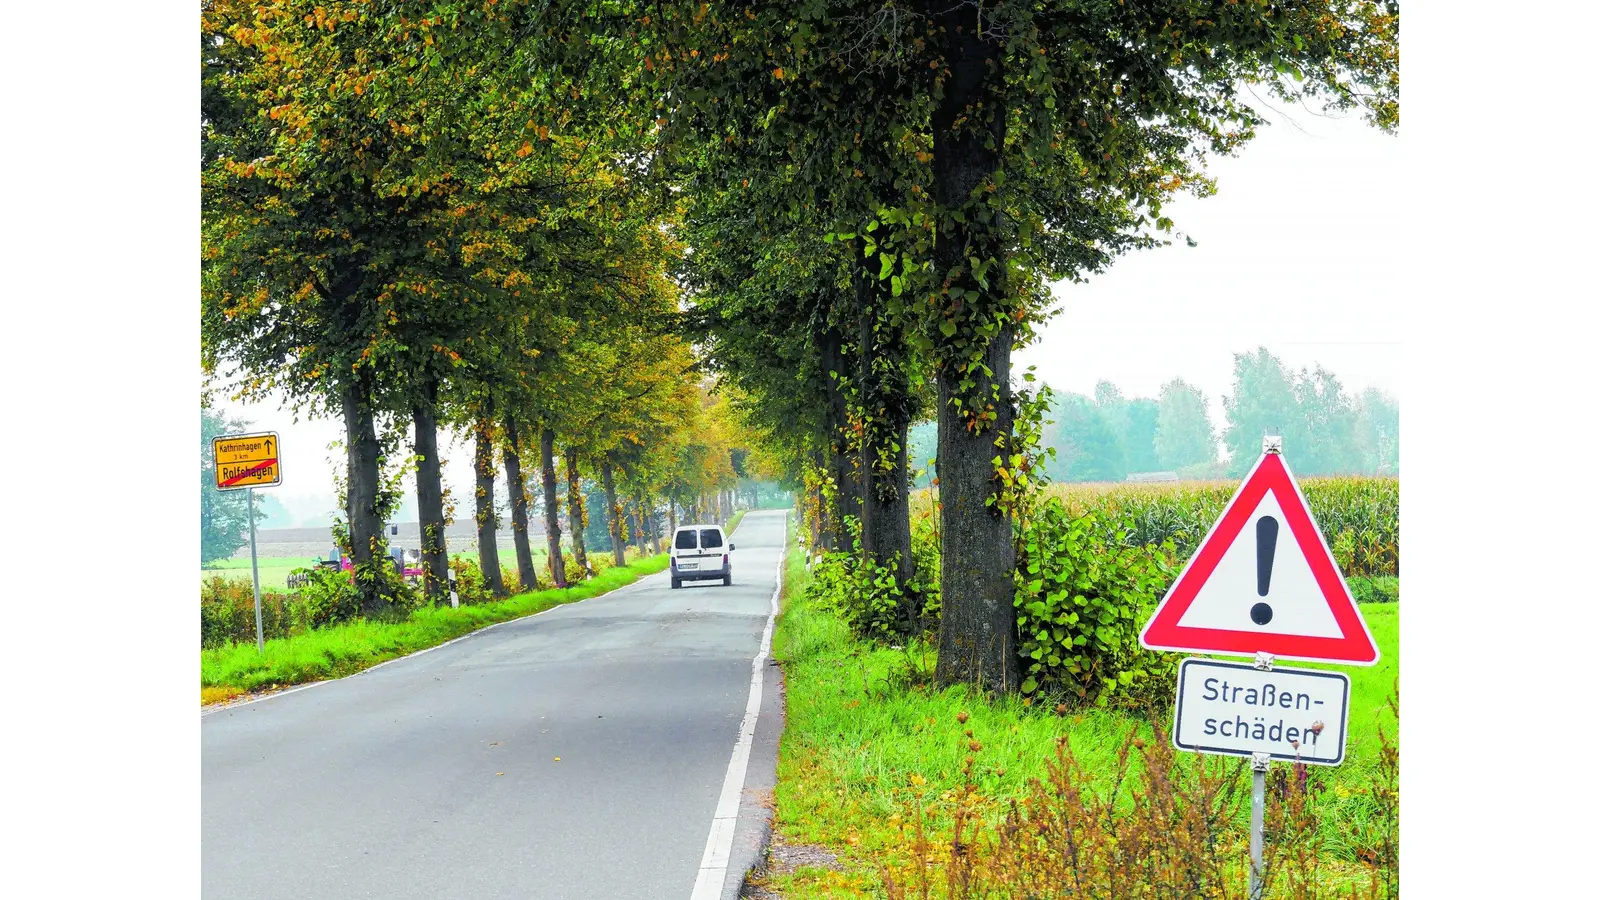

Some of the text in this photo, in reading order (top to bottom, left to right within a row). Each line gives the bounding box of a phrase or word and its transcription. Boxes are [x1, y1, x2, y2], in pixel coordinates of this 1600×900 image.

[219, 442, 262, 453] Kathrinhagen
[223, 466, 273, 480] Rolfshagen
[1202, 677, 1324, 711] Straßen-
[1203, 715, 1319, 746] schäden
